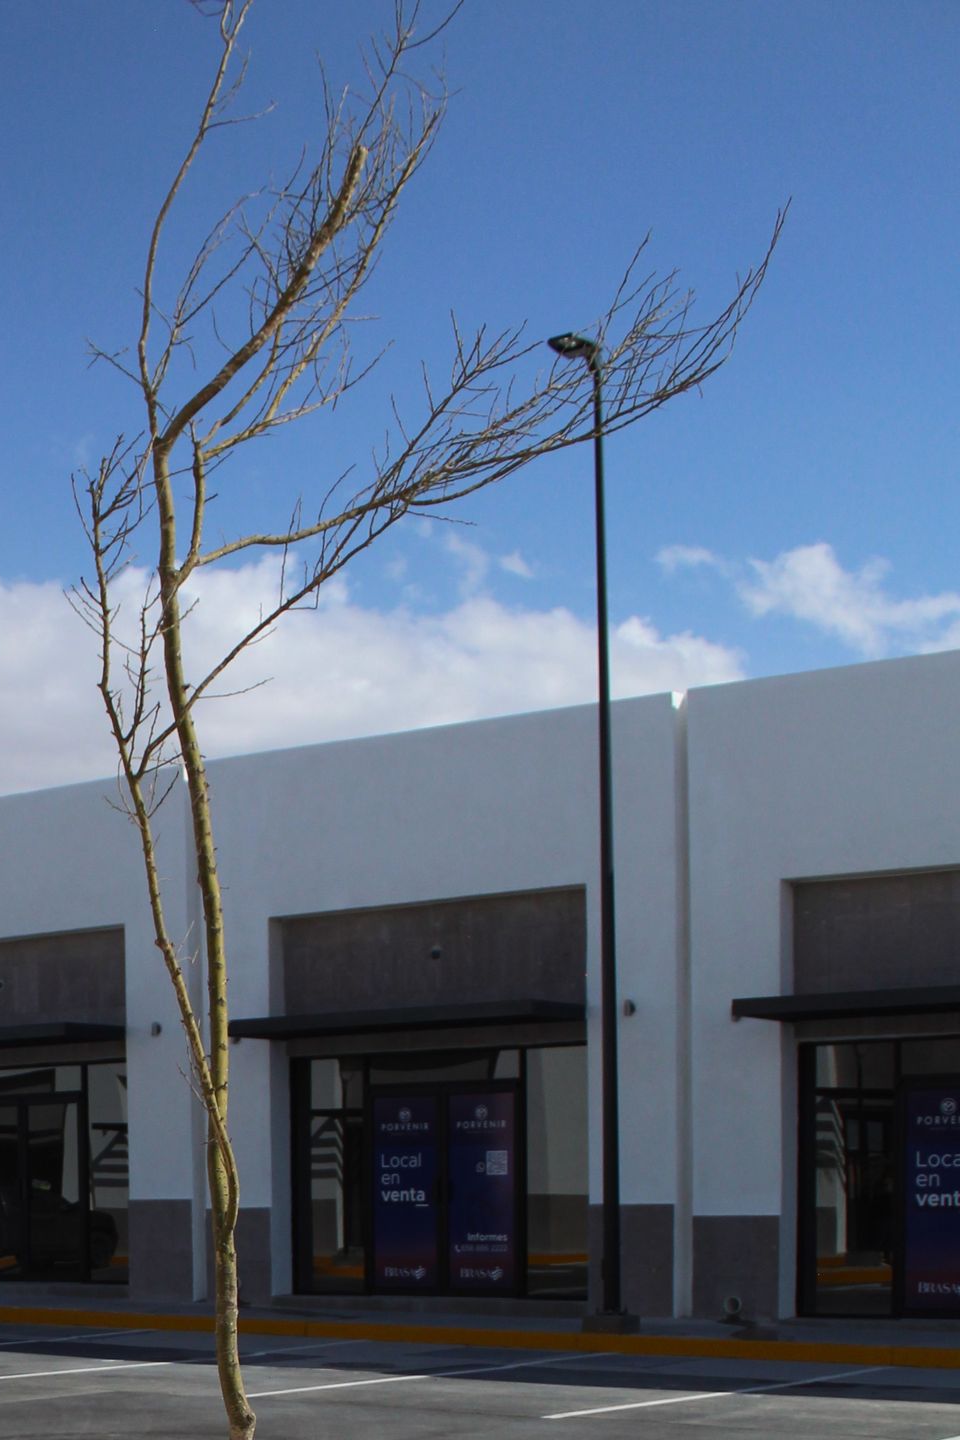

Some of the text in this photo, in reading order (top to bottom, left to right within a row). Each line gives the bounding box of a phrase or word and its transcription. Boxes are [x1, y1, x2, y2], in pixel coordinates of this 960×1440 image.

[381, 1122, 429, 1131] PORVENIR
[456, 1120, 507, 1129] PORVENIR
[916, 1115, 960, 1126] PORVE
[381, 1152, 422, 1168] Local
[916, 1150, 960, 1168] Loca
[381, 1173, 400, 1185] en
[916, 1173, 940, 1188] en
[381, 1187, 426, 1202] venta
[916, 1190, 960, 1207] vent
[467, 1232, 508, 1241] Informes
